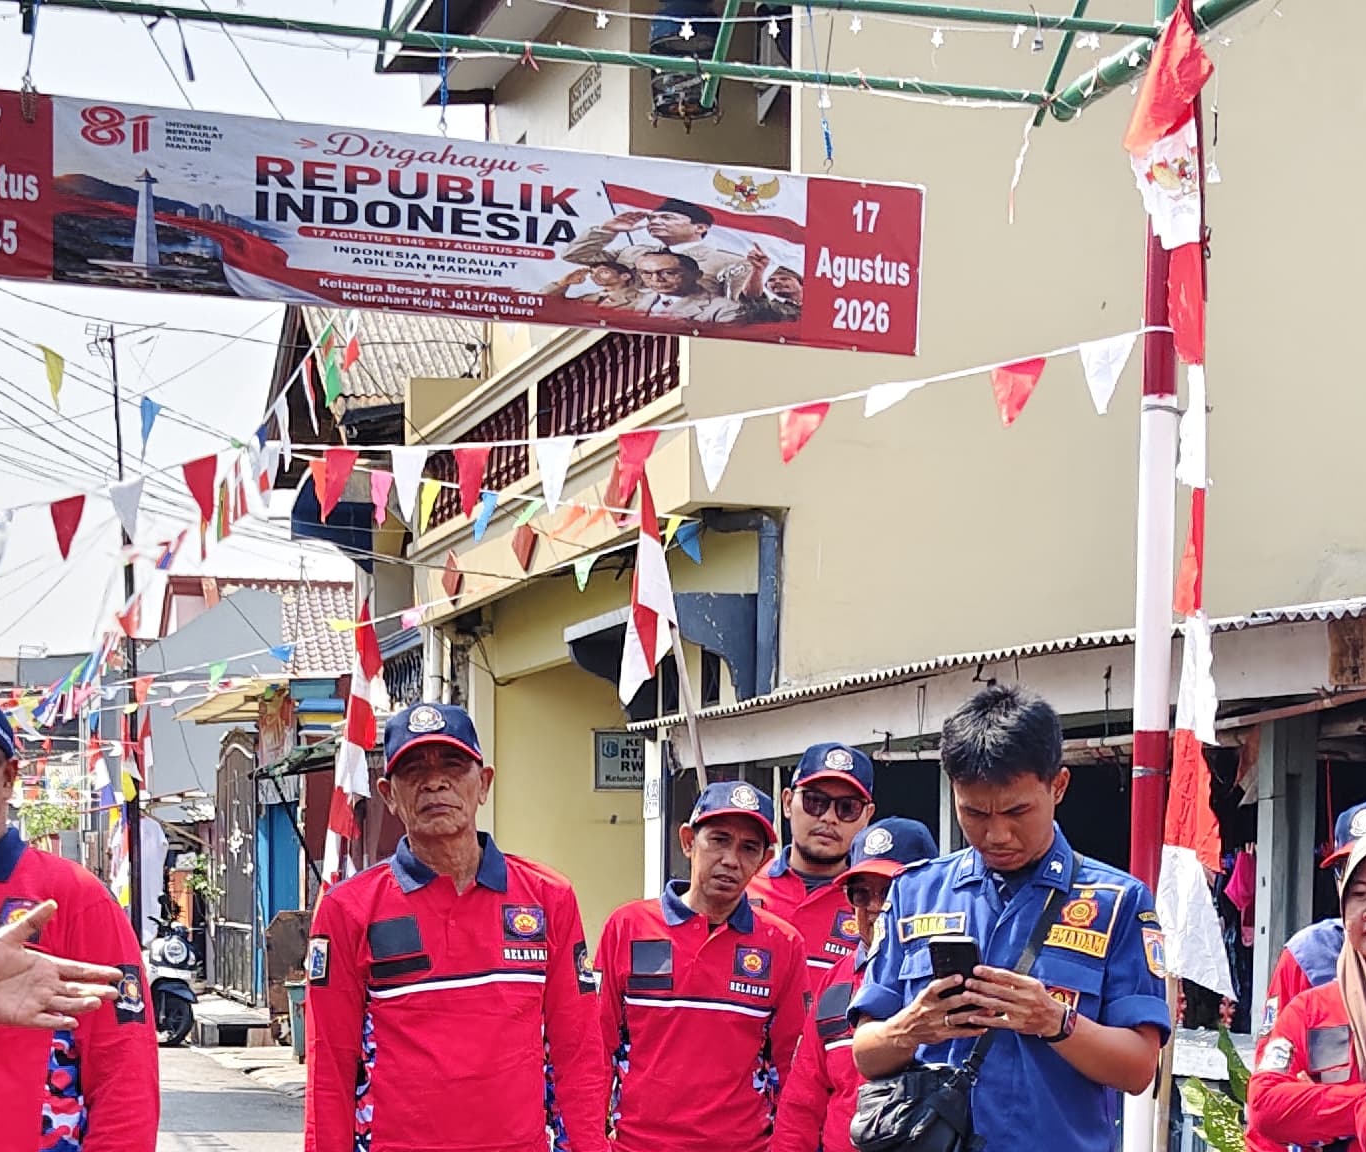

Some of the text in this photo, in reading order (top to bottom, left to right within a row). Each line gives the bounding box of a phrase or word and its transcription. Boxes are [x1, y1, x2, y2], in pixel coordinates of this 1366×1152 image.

[81, 104, 157, 154] 81
[323, 132, 521, 179] Dirgahayu
[255, 156, 580, 218] REPUBLIK
[255, 190, 577, 247] INDONESIA
[852, 200, 881, 233] 17
[331, 230, 391, 245] AGUSTUS
[454, 241, 513, 254] AGUSTUS
[333, 245, 518, 270] INDONESIA BERDAULAT
[352, 257, 502, 277] ADIL DAN MAKMUR
[815, 246, 911, 288] Agustus
[319, 277, 383, 294] Keluarga
[386, 283, 426, 297] Besar
[518, 295, 544, 307] 001
[342, 291, 409, 306] Kelurahan
[448, 300, 496, 313] Jakarta
[500, 306, 534, 318] Utara
[832, 298, 890, 334] 2026
[503, 948, 547, 960] RELAWA
[730, 980, 770, 997] RELAWAN
